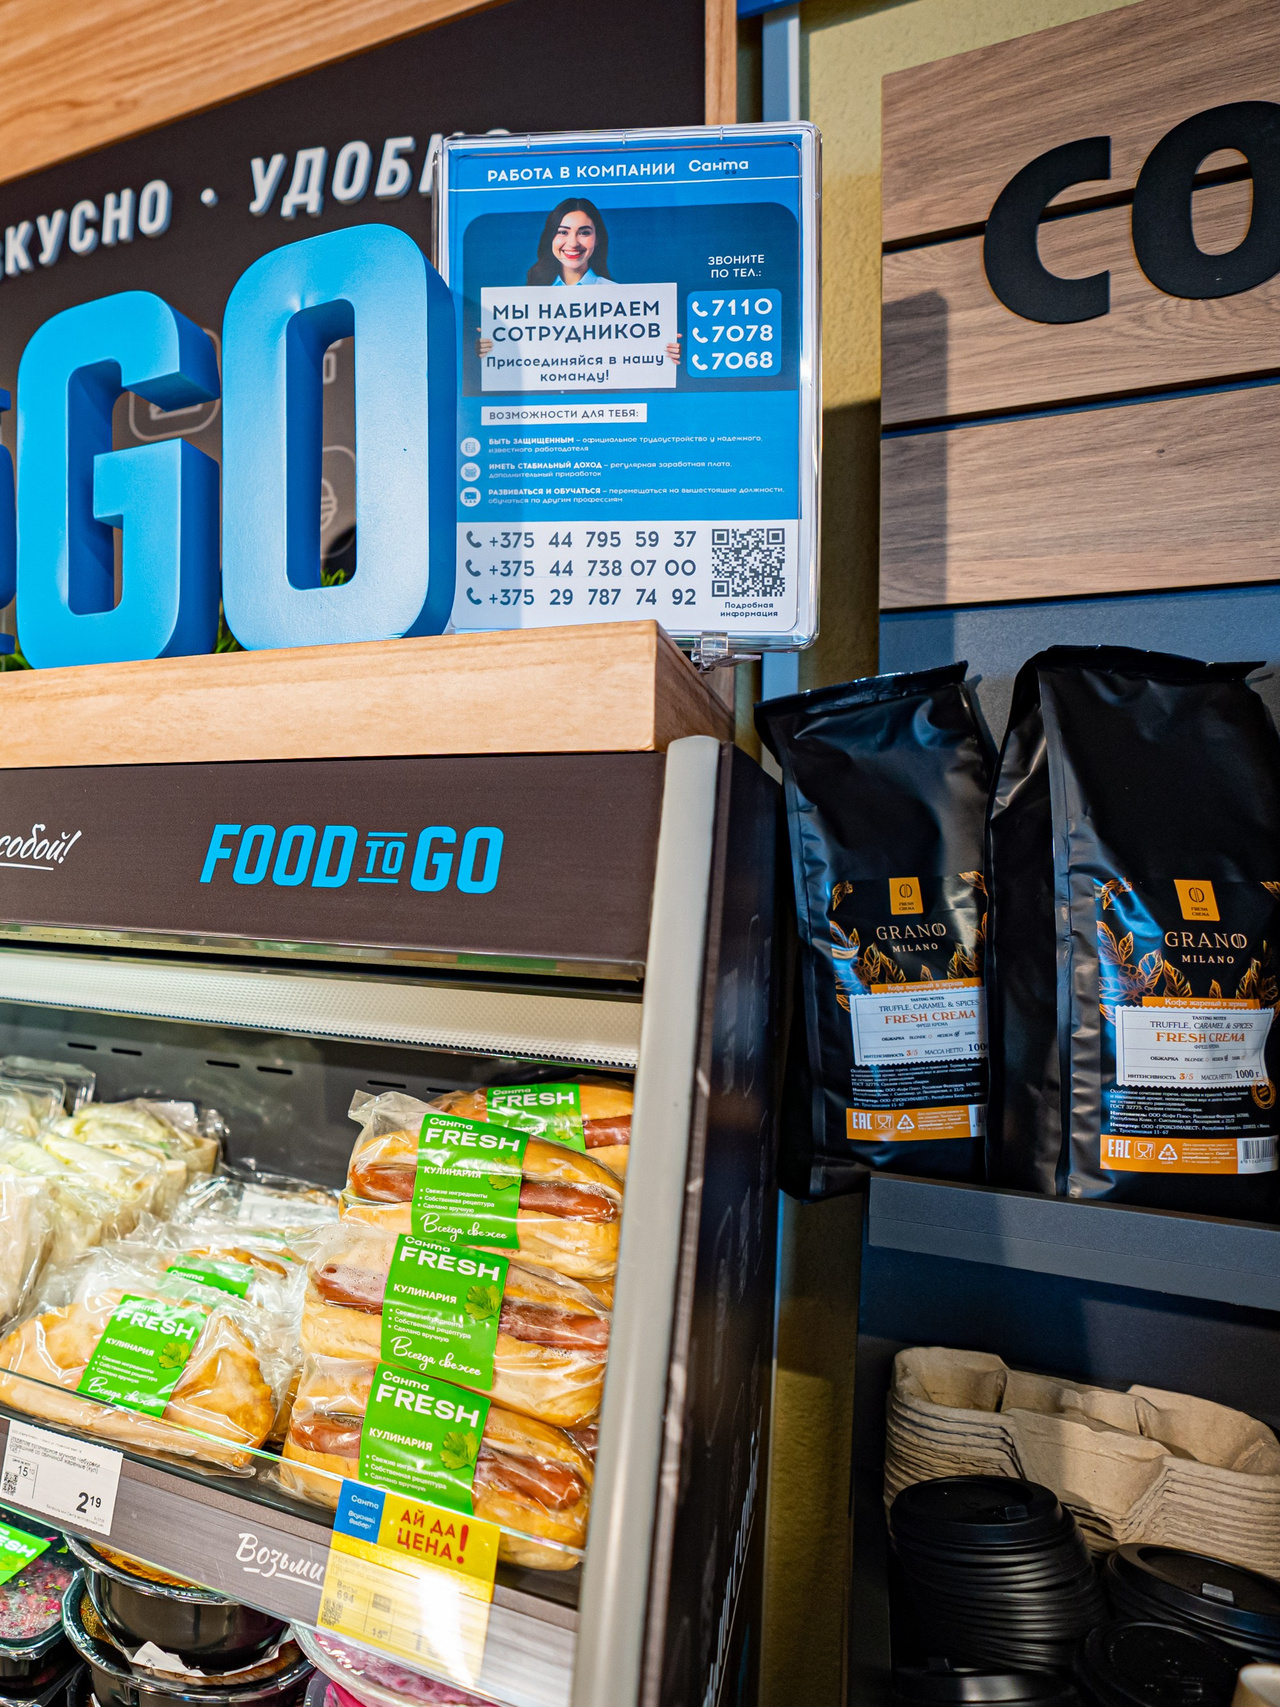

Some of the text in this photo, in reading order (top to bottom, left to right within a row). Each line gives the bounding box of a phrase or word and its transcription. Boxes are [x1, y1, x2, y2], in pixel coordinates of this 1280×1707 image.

[249, 129, 510, 220] УДОБ
[487, 159, 749, 183] РАБОТА В КОМПАНИИ Санта
[708, 254, 765, 266] ЗВОНИТЕ
[711, 268, 762, 279] ПО ТЕЛ.:
[493, 301, 660, 320] МЫ НАБИРАЕМ
[711, 297, 773, 317] 7110
[492, 323, 661, 344] СОТРУДНИКОВ
[711, 325, 773, 343] 7078
[487, 353, 664, 369] Присоединяйся в нашу
[711, 351, 773, 370] 7068
[540, 369, 609, 383] команду!
[489, 408, 639, 421] ВОЗМОЖНОСТИ ДЛЯ ТЕБЯ:
[17, 223, 456, 671] GO
[513, 437, 574, 445] ЗАЩИЩЕННЫМ
[518, 461, 572, 469] СТАБИЛЬНЫЙ
[610, 461, 656, 469] регулярная
[542, 497, 572, 505] другим
[489, 531, 697, 548] +375 44 795 59 37
[489, 559, 697, 577] +375 44 738 07 00
[489, 588, 697, 606] +375 29 787 74 92
[719, 610, 778, 618] информация
[724, 602, 774, 610] Подробная
[199, 823, 505, 894] FOOD TO GO
[876, 922, 947, 941] GRANO
[1164, 931, 1248, 949] GRANO
[892, 943, 939, 953] MILANO
[1182, 955, 1235, 964] MILANO
[912, 1002, 946, 1010] CARAMEL
[955, 999, 980, 1007] SPICES
[1165, 998, 1188, 1007] Кофе
[885, 1010, 976, 1024] FRESH CREMA
[1150, 1021, 1191, 1029] TRUFFLE,
[1156, 1031, 1245, 1043] FRESH CREMA
[1179, 1072, 1194, 1080] 3/5
[1235, 1069, 1255, 1079] 1000
[491, 1091, 575, 1108] FRESH
[429, 1117, 474, 1131] Санта
[424, 1127, 521, 1152] FRESH
[424, 1166, 482, 1179] КУЛИНАРИЯ
[425, 1187, 488, 1199] Свежие ингредиенты
[422, 1202, 475, 1214] Сделано вручную
[424, 1195, 495, 1209] Собственная рецептура
[419, 1212, 508, 1242] Всегда свежее
[404, 1236, 451, 1253] Санта
[399, 1245, 500, 1282] FRESH
[170, 1269, 205, 1282] Санта
[393, 1283, 458, 1305] КУЛИНАРИЯ
[395, 1308, 420, 1319] Свежие
[116, 1309, 196, 1340] FRESH
[394, 1316, 472, 1340] Собственная рецептура
[393, 1324, 450, 1343] Сделано вручную
[104, 1337, 155, 1357] КУЛИНАРИЯ
[390, 1335, 482, 1376] Всегда свежее
[382, 1371, 430, 1391] Санта
[375, 1383, 480, 1428] FRESH
[369, 1427, 433, 1452] КУЛИНАРИЯ
[351, 1494, 379, 1510] Санта
[400, 1508, 456, 1539] АЙ ДА
[235, 1532, 325, 1581] Возьми
[336, 1580, 358, 1595] Весы
[336, 1589, 355, 1604] 694
